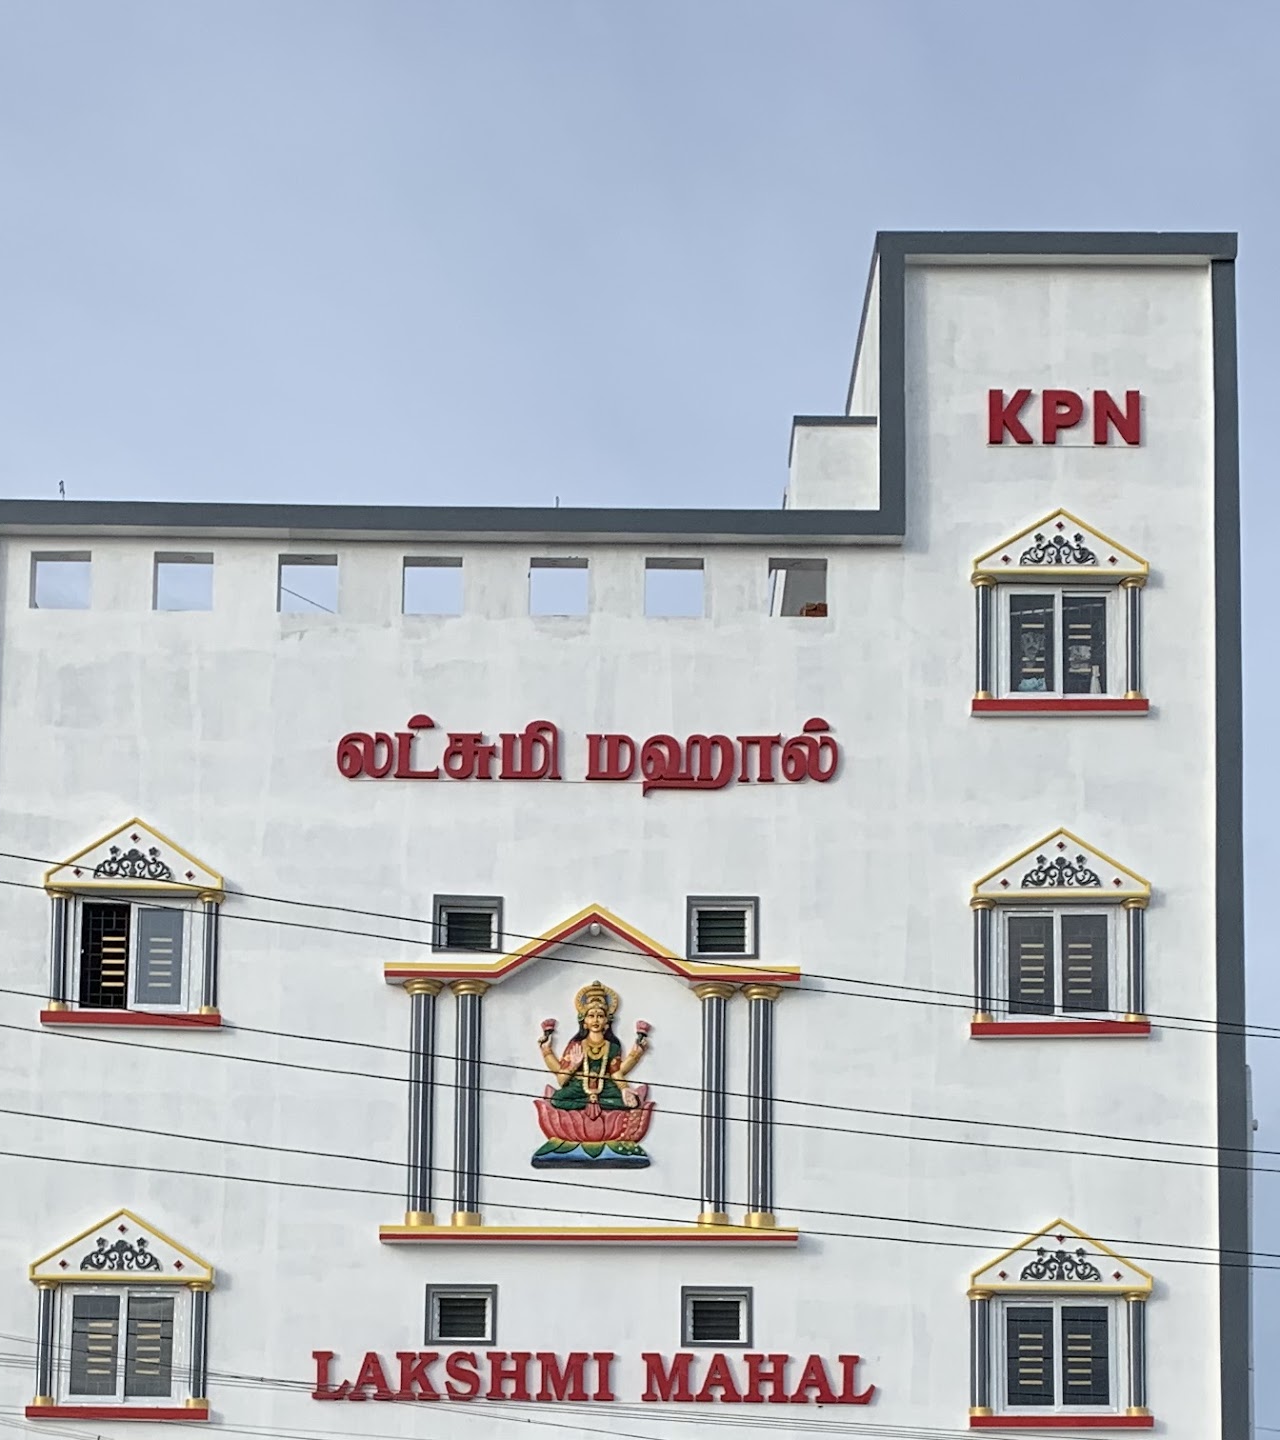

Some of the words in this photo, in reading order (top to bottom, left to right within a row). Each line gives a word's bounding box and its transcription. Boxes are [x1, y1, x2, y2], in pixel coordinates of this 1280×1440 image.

[989, 389, 1140, 444] KPN
[337, 714, 562, 780] லட்சுமி
[585, 717, 839, 797] மஹால்
[311, 1351, 615, 1402] LAKSHMI
[641, 1353, 877, 1405] MAHAL
